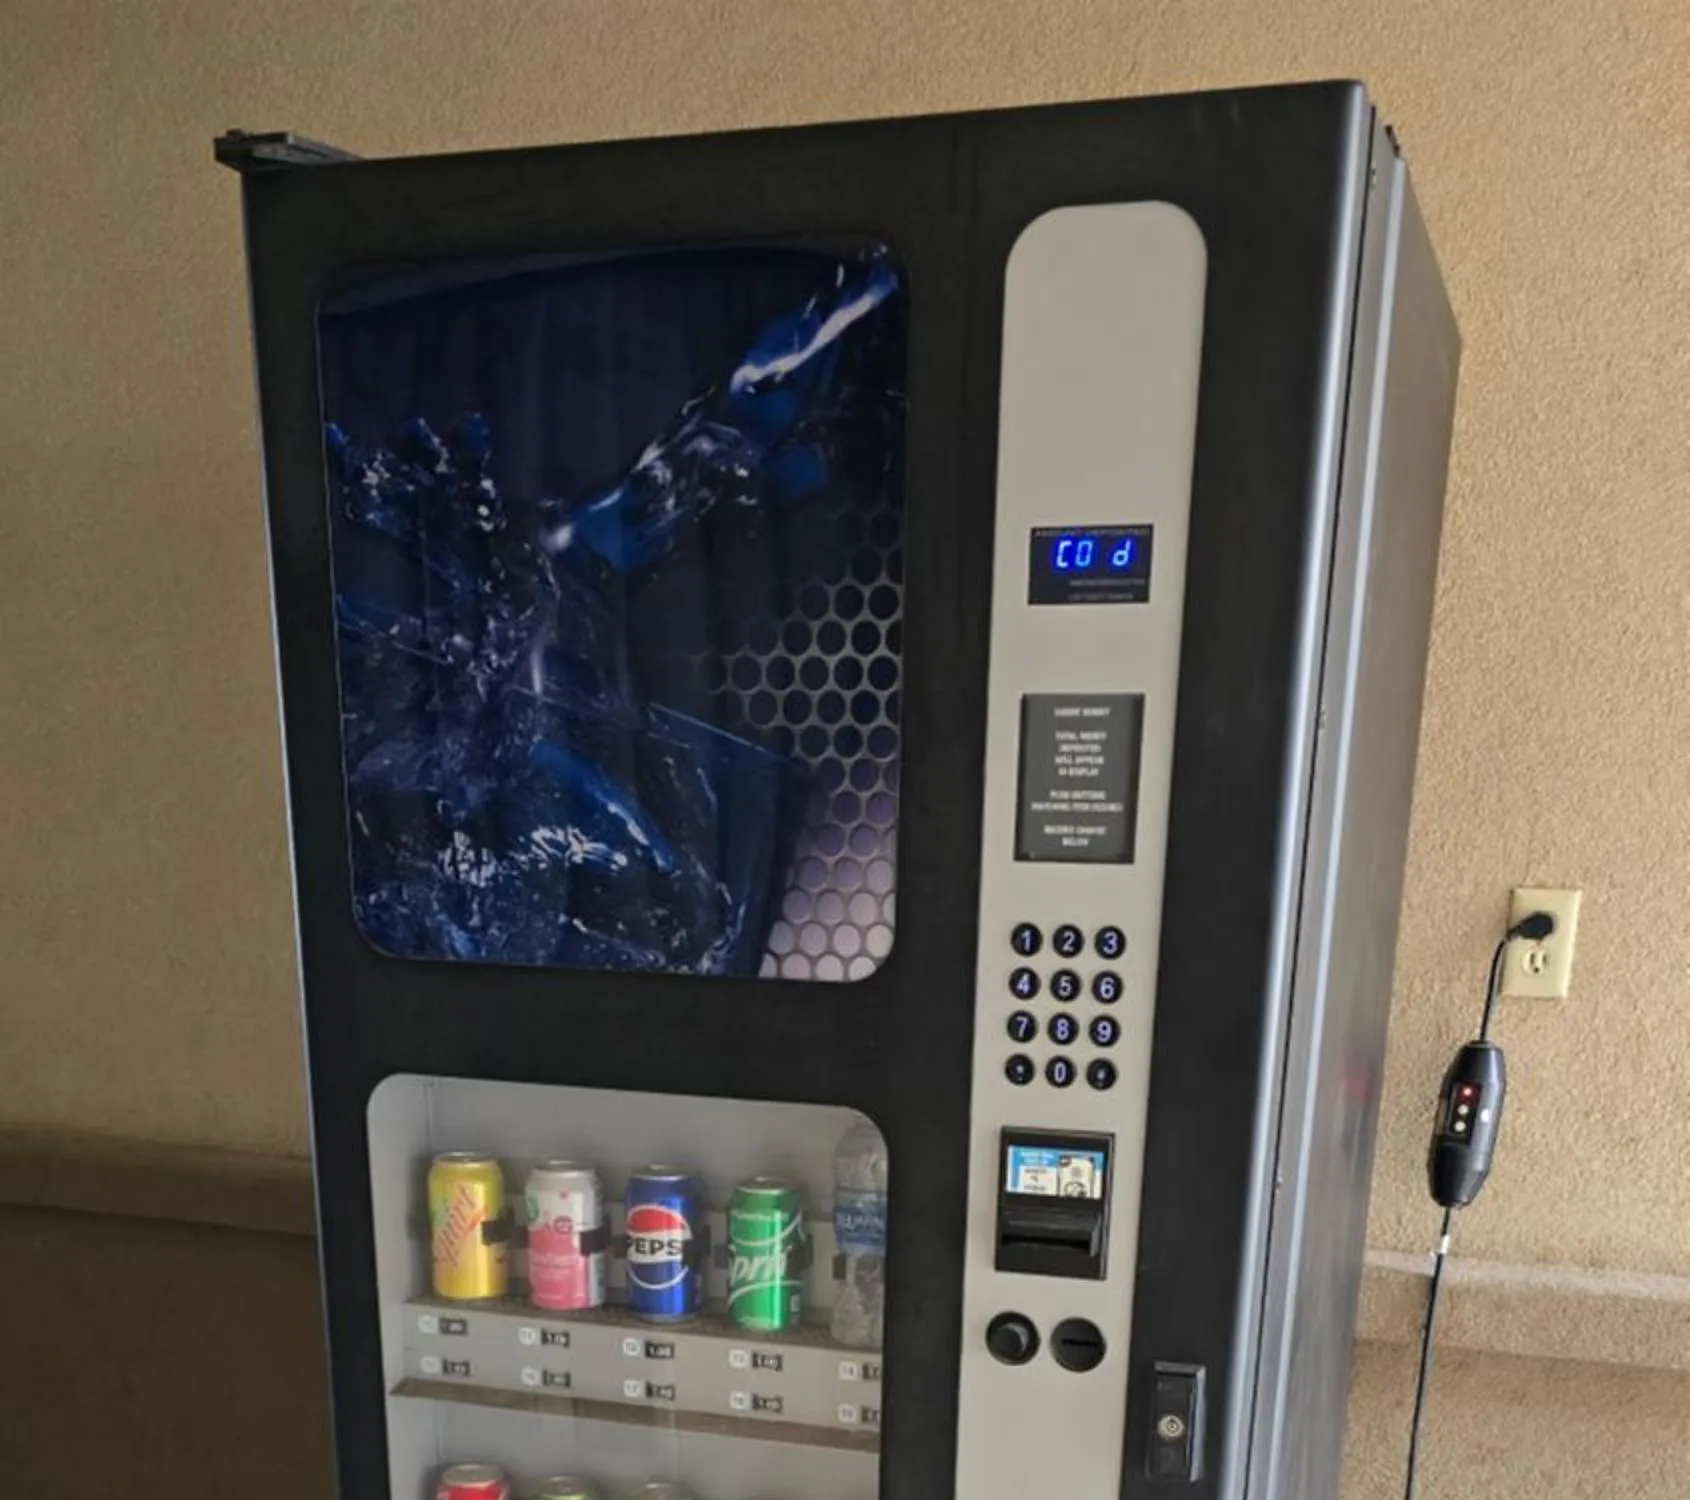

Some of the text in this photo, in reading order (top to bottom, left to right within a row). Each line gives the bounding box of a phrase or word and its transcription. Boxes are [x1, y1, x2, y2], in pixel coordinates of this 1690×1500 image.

[1021, 930, 1032, 951] 1
[1062, 931, 1075, 951] 2
[1103, 931, 1118, 954] 3
[1016, 972, 1030, 994] 4
[1058, 975, 1072, 997] 5
[1101, 977, 1114, 999] 6
[1016, 1015, 1029, 1038] 7
[1057, 1017, 1069, 1040] 8
[1098, 1021, 1112, 1042] 9
[1054, 1062, 1067, 1083] 0
[625, 1237, 686, 1257] EPS
